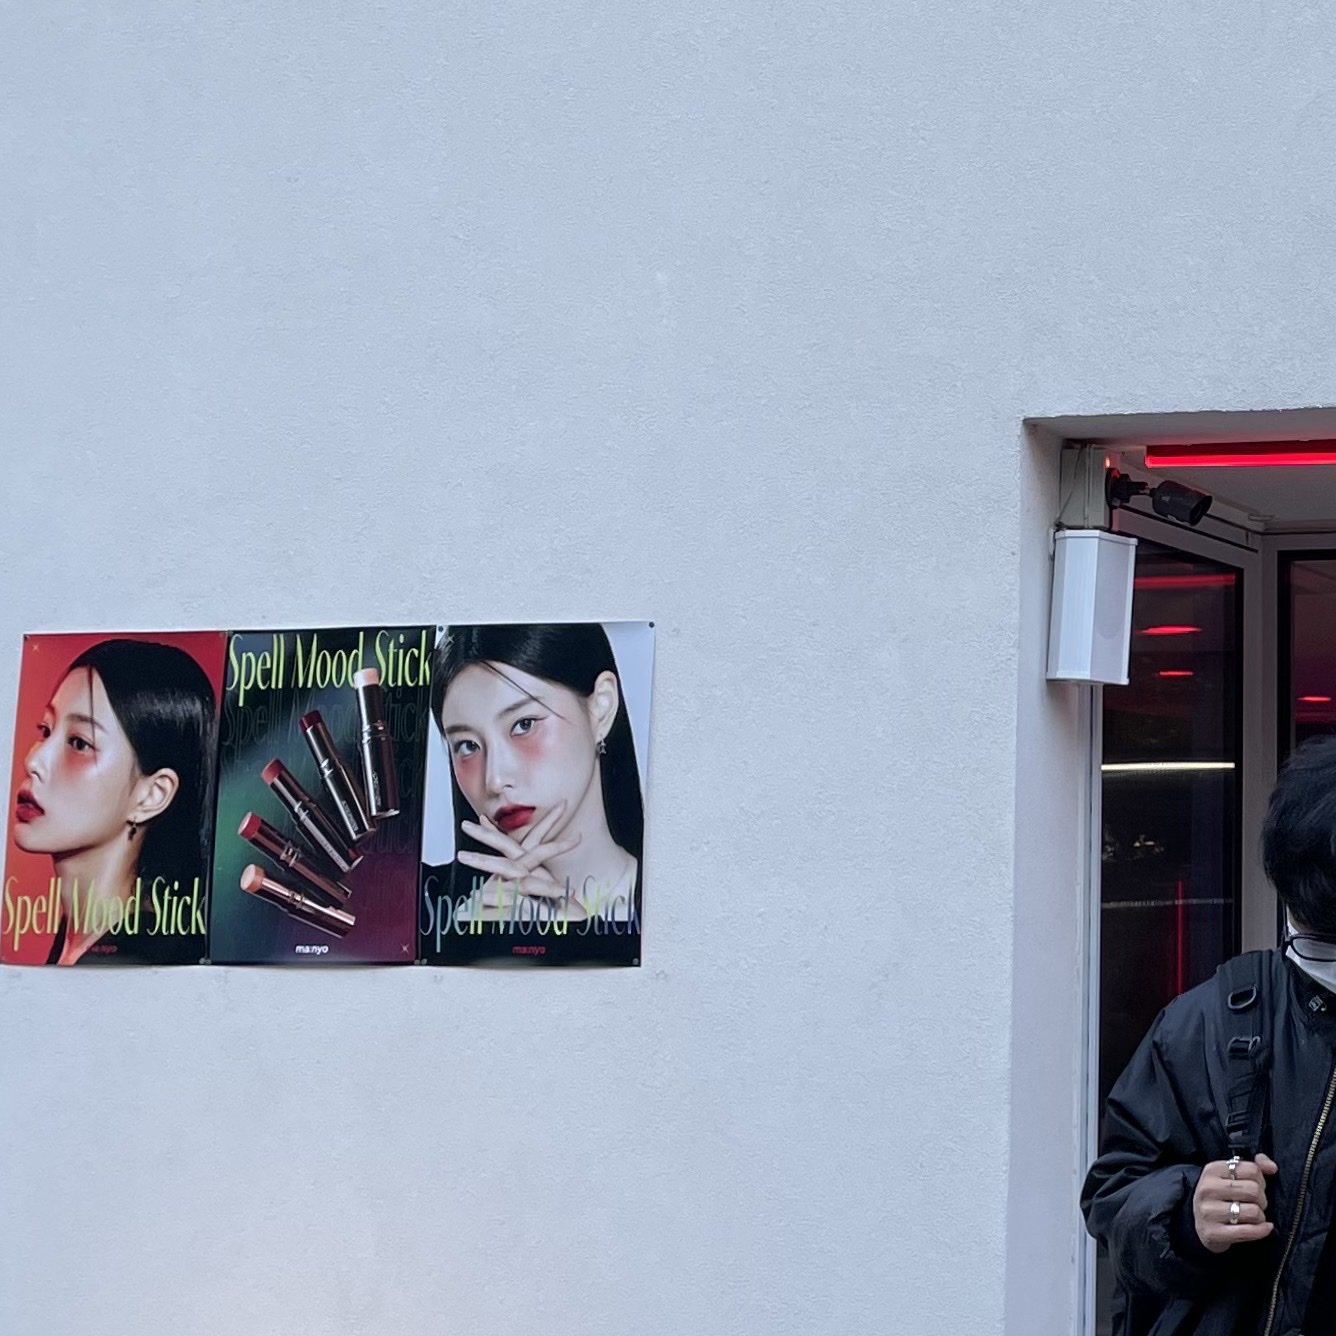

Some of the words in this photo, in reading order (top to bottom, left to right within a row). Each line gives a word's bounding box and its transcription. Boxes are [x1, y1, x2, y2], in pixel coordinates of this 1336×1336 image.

[226, 633, 286, 707] Spell
[291, 631, 364, 689] Mood
[375, 630, 431, 688] Stick
[3, 876, 62, 952] Spell
[66, 877, 141, 935] Mood
[147, 876, 206, 936] Stick
[420, 875, 485, 953] Spell
[491, 876, 571, 936] Mood
[576, 875, 641, 936] Stick
